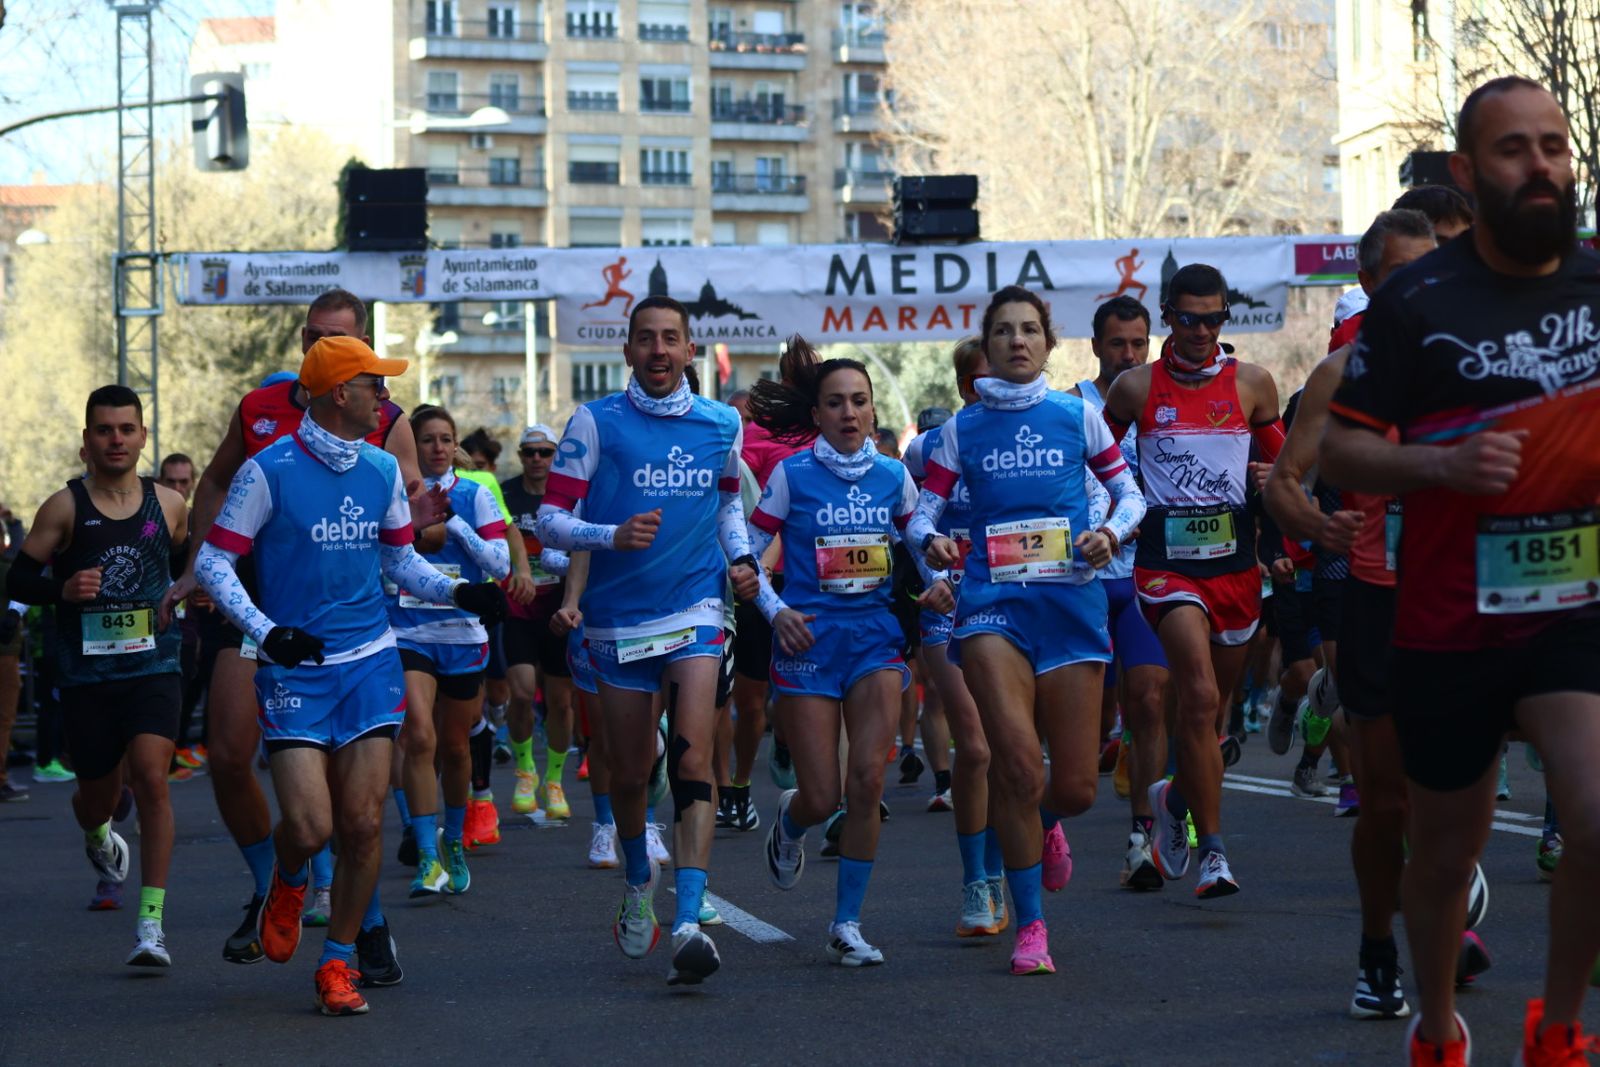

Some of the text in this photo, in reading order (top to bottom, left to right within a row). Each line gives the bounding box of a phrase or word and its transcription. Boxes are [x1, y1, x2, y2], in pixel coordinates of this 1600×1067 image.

[1322, 245, 1358, 261] LAB
[243, 261, 340, 280] Ayuntamiento
[442, 257, 538, 277] Ayuntamiento
[825, 249, 1055, 296] MEDIA
[243, 281, 261, 297] de
[442, 276, 540, 294] de Salamanca
[822, 304, 977, 333] MARAT
[1227, 311, 1284, 327] MANCA
[577, 325, 627, 340] CIUDA
[688, 325, 778, 339] ALAMANCA
[982, 444, 1064, 472] debra
[1154, 437, 1199, 467] Simón
[633, 463, 713, 488] debra
[993, 469, 1056, 480] Piel de Mariposa
[1170, 464, 1233, 493] Martín
[643, 489, 705, 498] Piel de Mariposa
[816, 502, 889, 526] debra
[311, 516, 379, 542] debra
[828, 526, 841, 534] Piel
[1186, 518, 1220, 534] 400
[322, 543, 334, 551] Piel
[334, 542, 344, 550] de
[1018, 534, 1044, 551] 12
[1505, 533, 1581, 565] 1851
[100, 545, 141, 563] LIEBRES
[846, 549, 869, 565] 10
[120, 582, 141, 598] CLUB
[102, 614, 136, 629] 843
[265, 695, 302, 711] ebra
